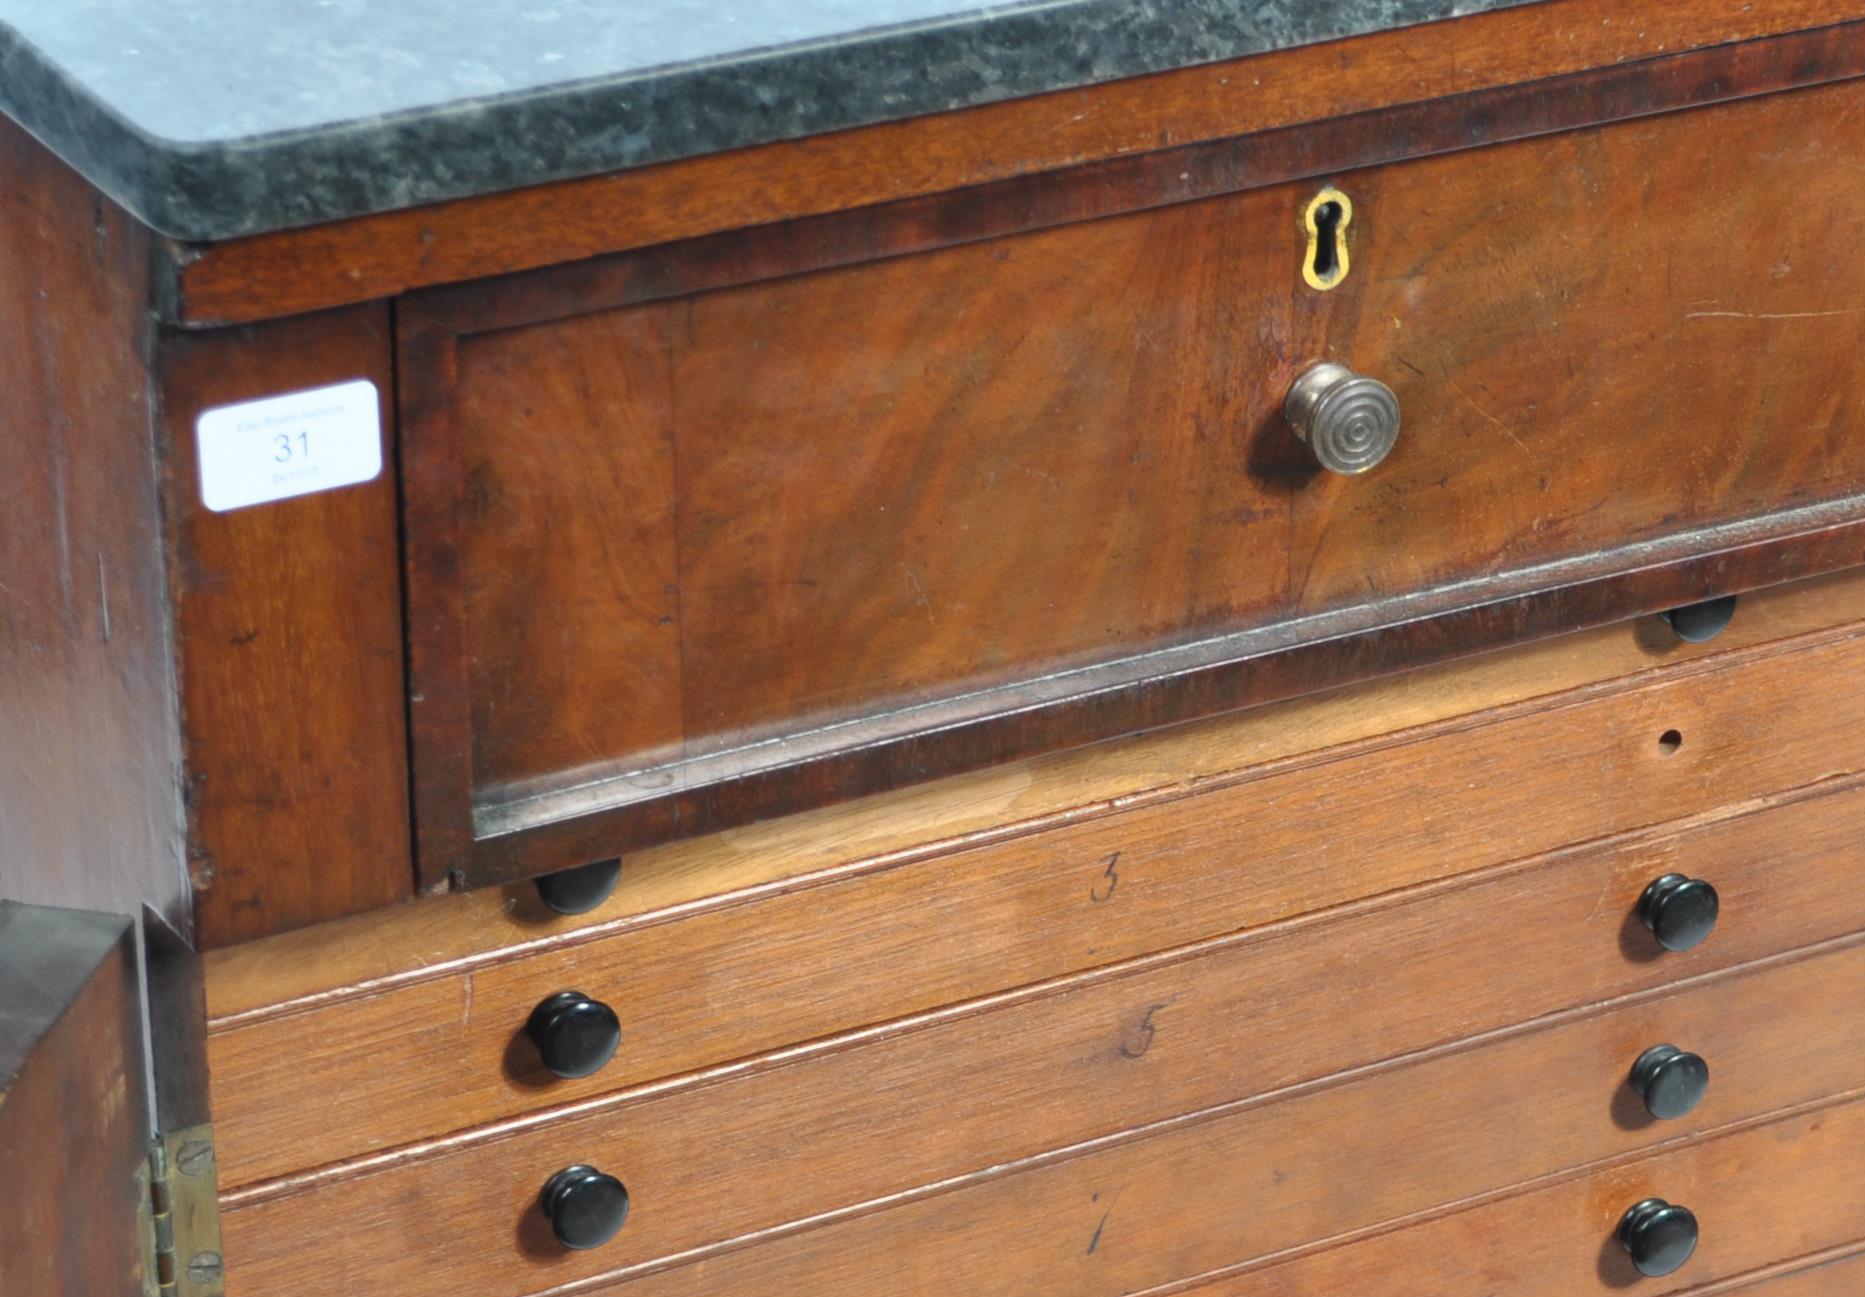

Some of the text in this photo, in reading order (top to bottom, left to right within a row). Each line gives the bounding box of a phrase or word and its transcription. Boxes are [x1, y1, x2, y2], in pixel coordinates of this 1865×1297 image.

[274, 431, 308, 463] 31
[1089, 850, 1122, 902] 3
[1118, 997, 1168, 1060] 5
